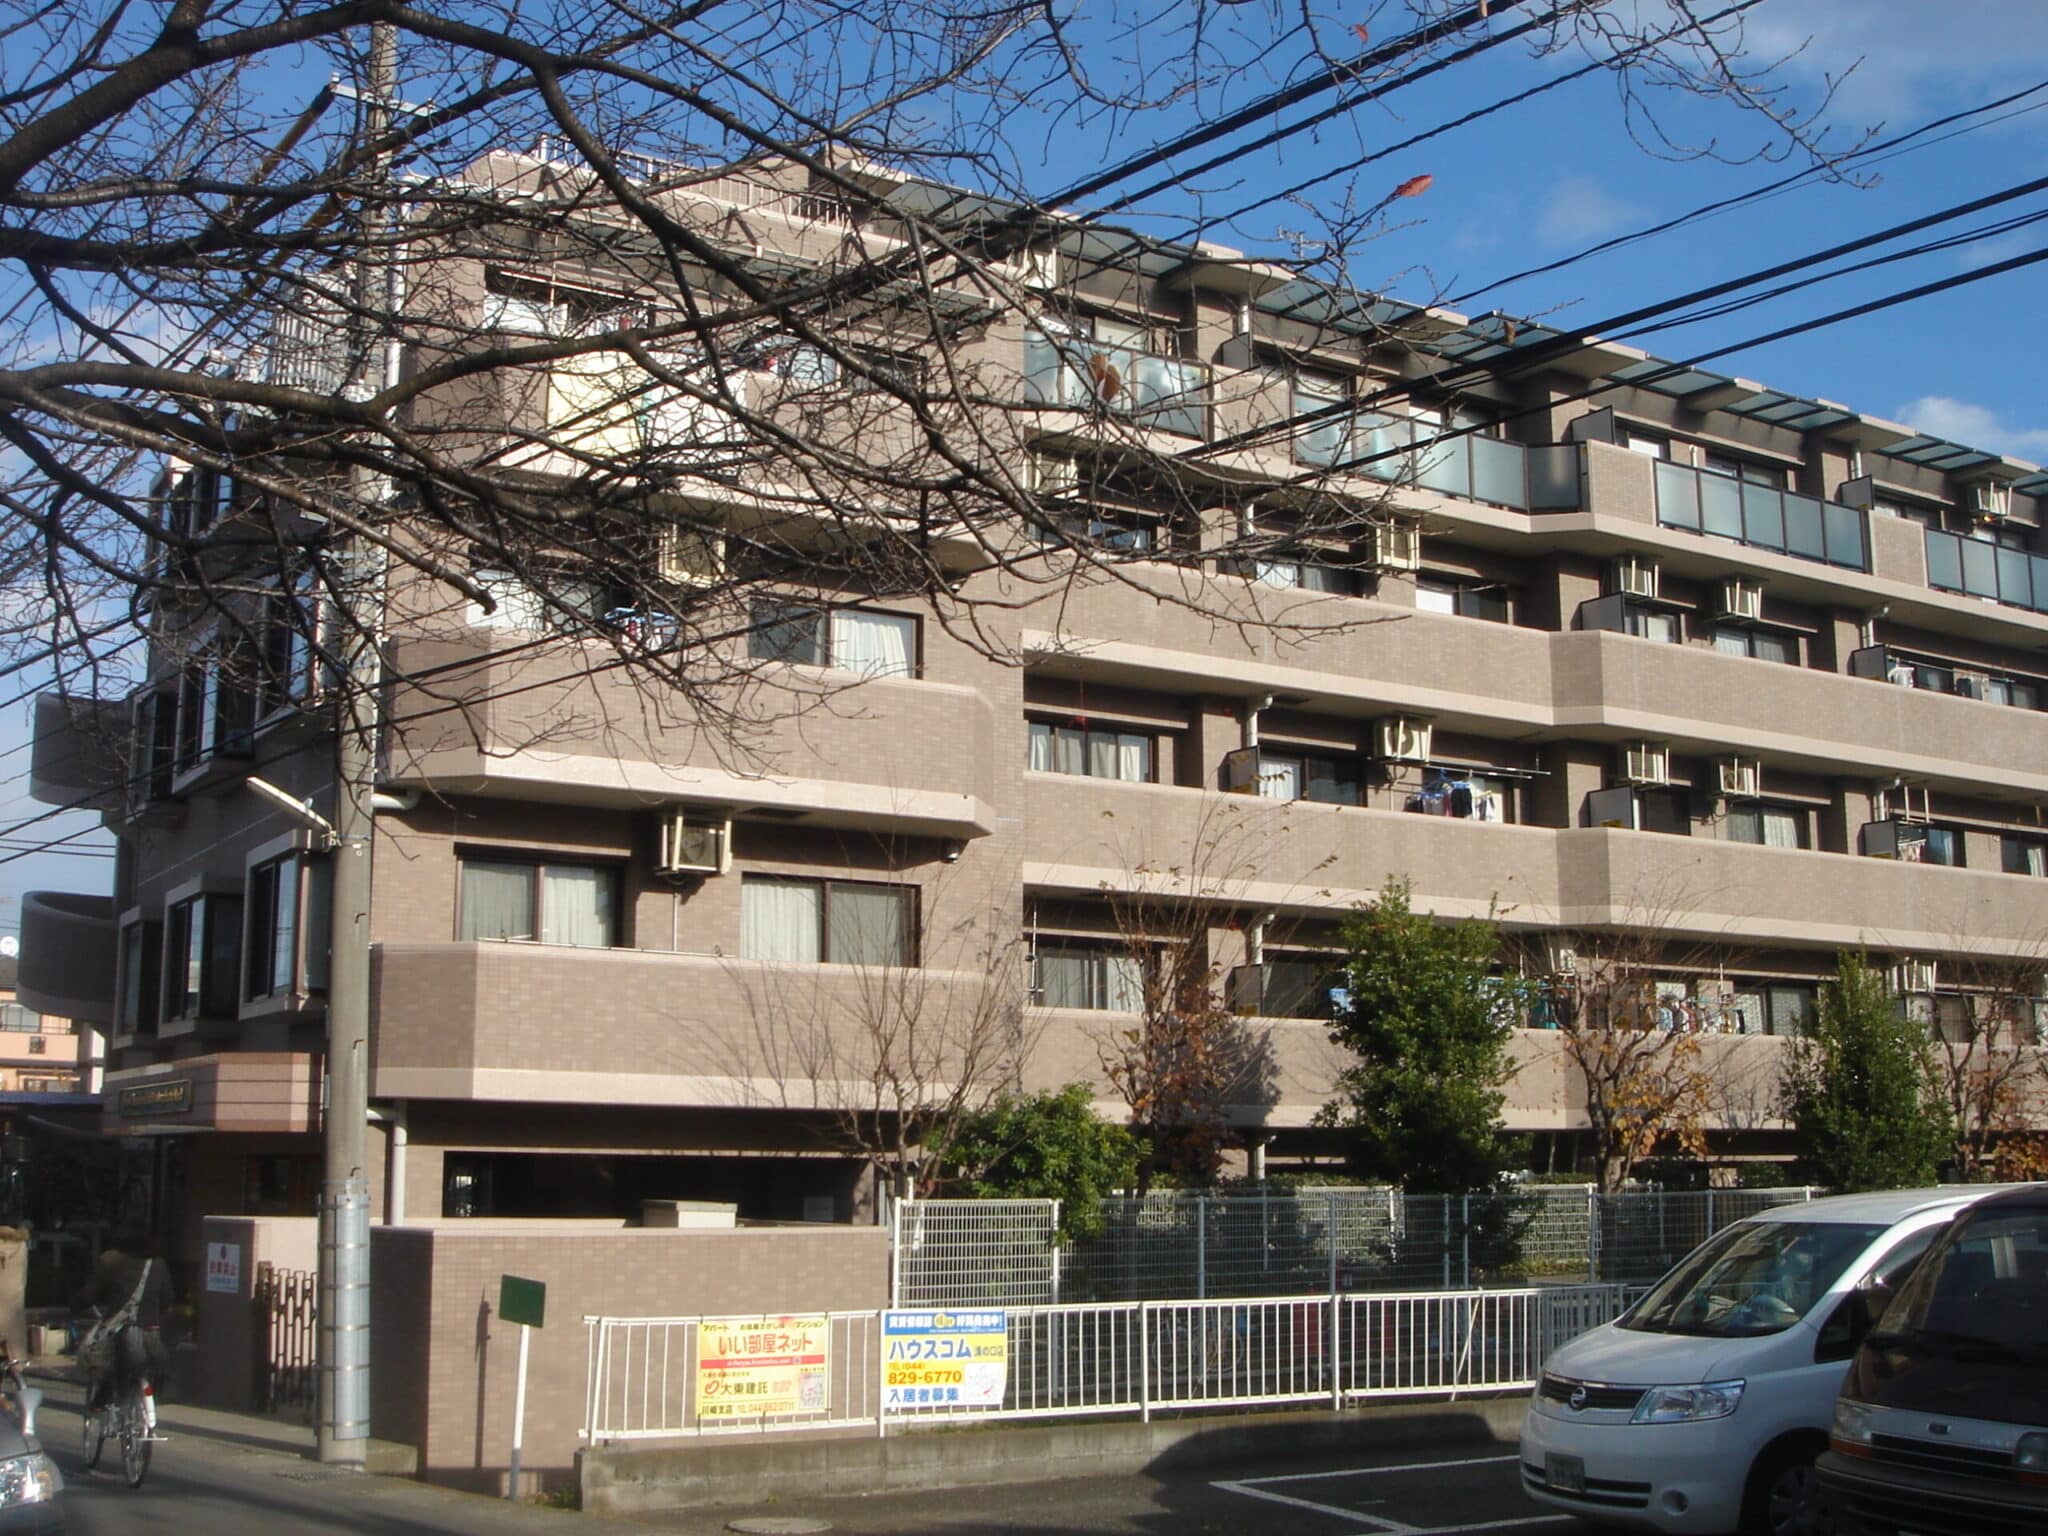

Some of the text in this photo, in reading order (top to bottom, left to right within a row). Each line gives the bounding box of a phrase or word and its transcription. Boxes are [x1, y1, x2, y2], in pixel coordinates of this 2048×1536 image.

[704, 1324, 729, 1333] アパート
[794, 1320, 824, 1329] マンション
[719, 1332, 814, 1355] いい部屋ネット
[889, 1338, 972, 1360] ハウスコム
[888, 1370, 963, 1384] 829-6770
[721, 1381, 769, 1395] 大東建託
[889, 1387, 960, 1403] 入居者募集
[702, 1405, 733, 1416] 川崎支店
